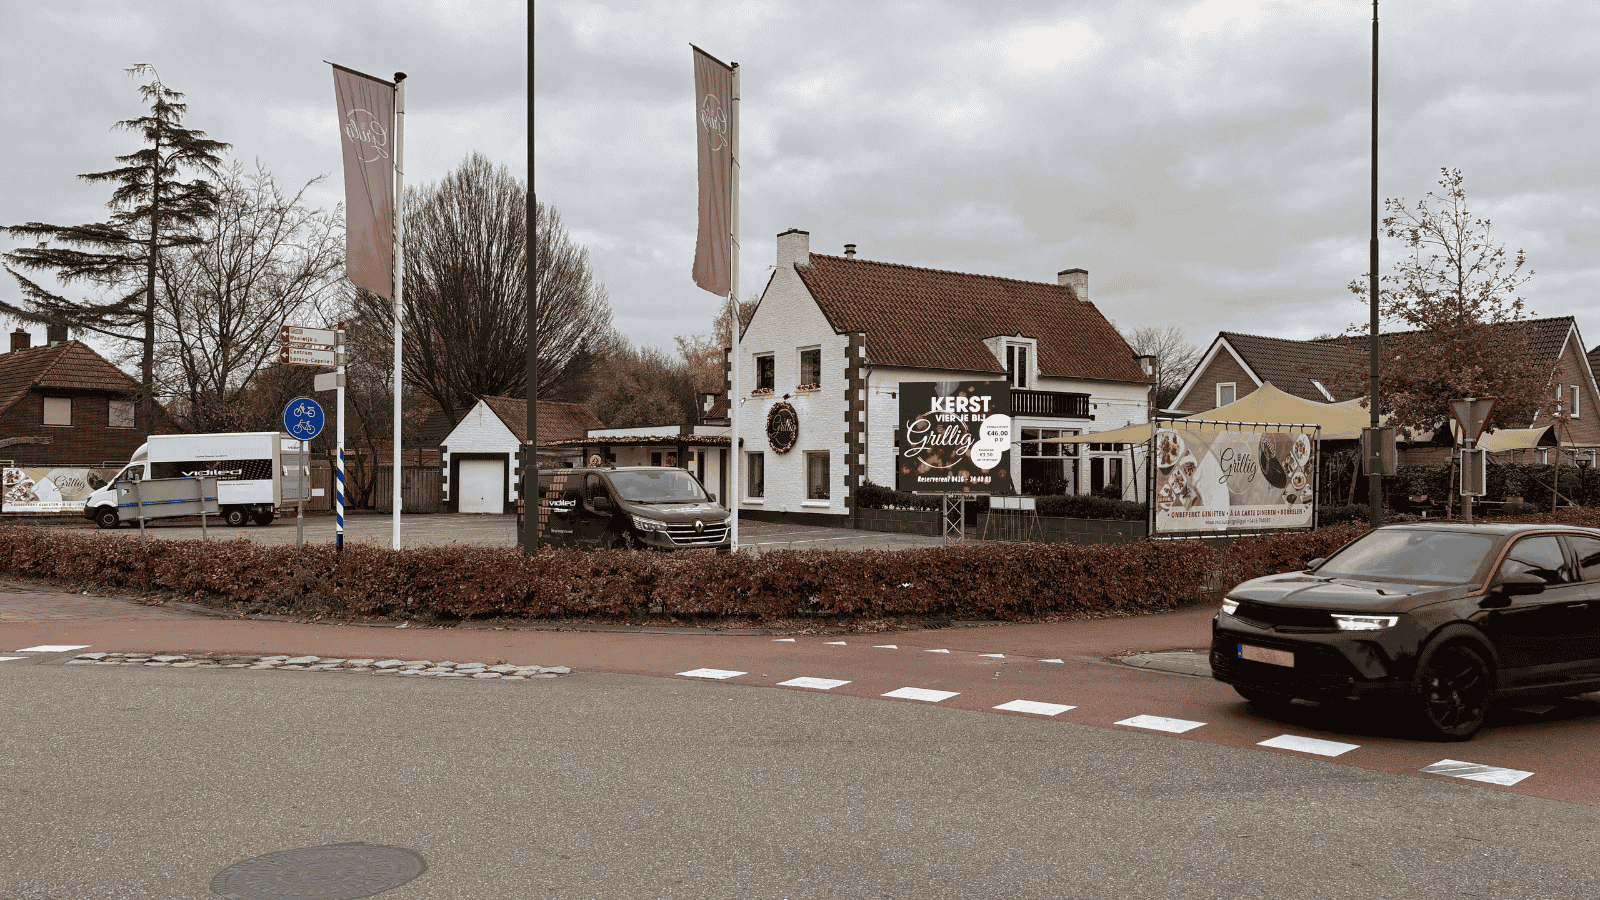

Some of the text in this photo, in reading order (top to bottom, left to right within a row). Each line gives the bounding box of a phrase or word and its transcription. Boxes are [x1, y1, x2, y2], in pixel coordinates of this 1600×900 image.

[931, 395, 992, 413] KERST
[935, 413, 986, 422] VIER JE BIJ
[904, 418, 975, 458] Grillig
[1218, 447, 1259, 484] Grillig
[52, 475, 86, 492] Grillig
[917, 475, 951, 483] Reserveren?
[951, 475, 965, 483] 0416
[548, 499, 577, 507] vidiled
[1201, 510, 1226, 518] GENIETEN
